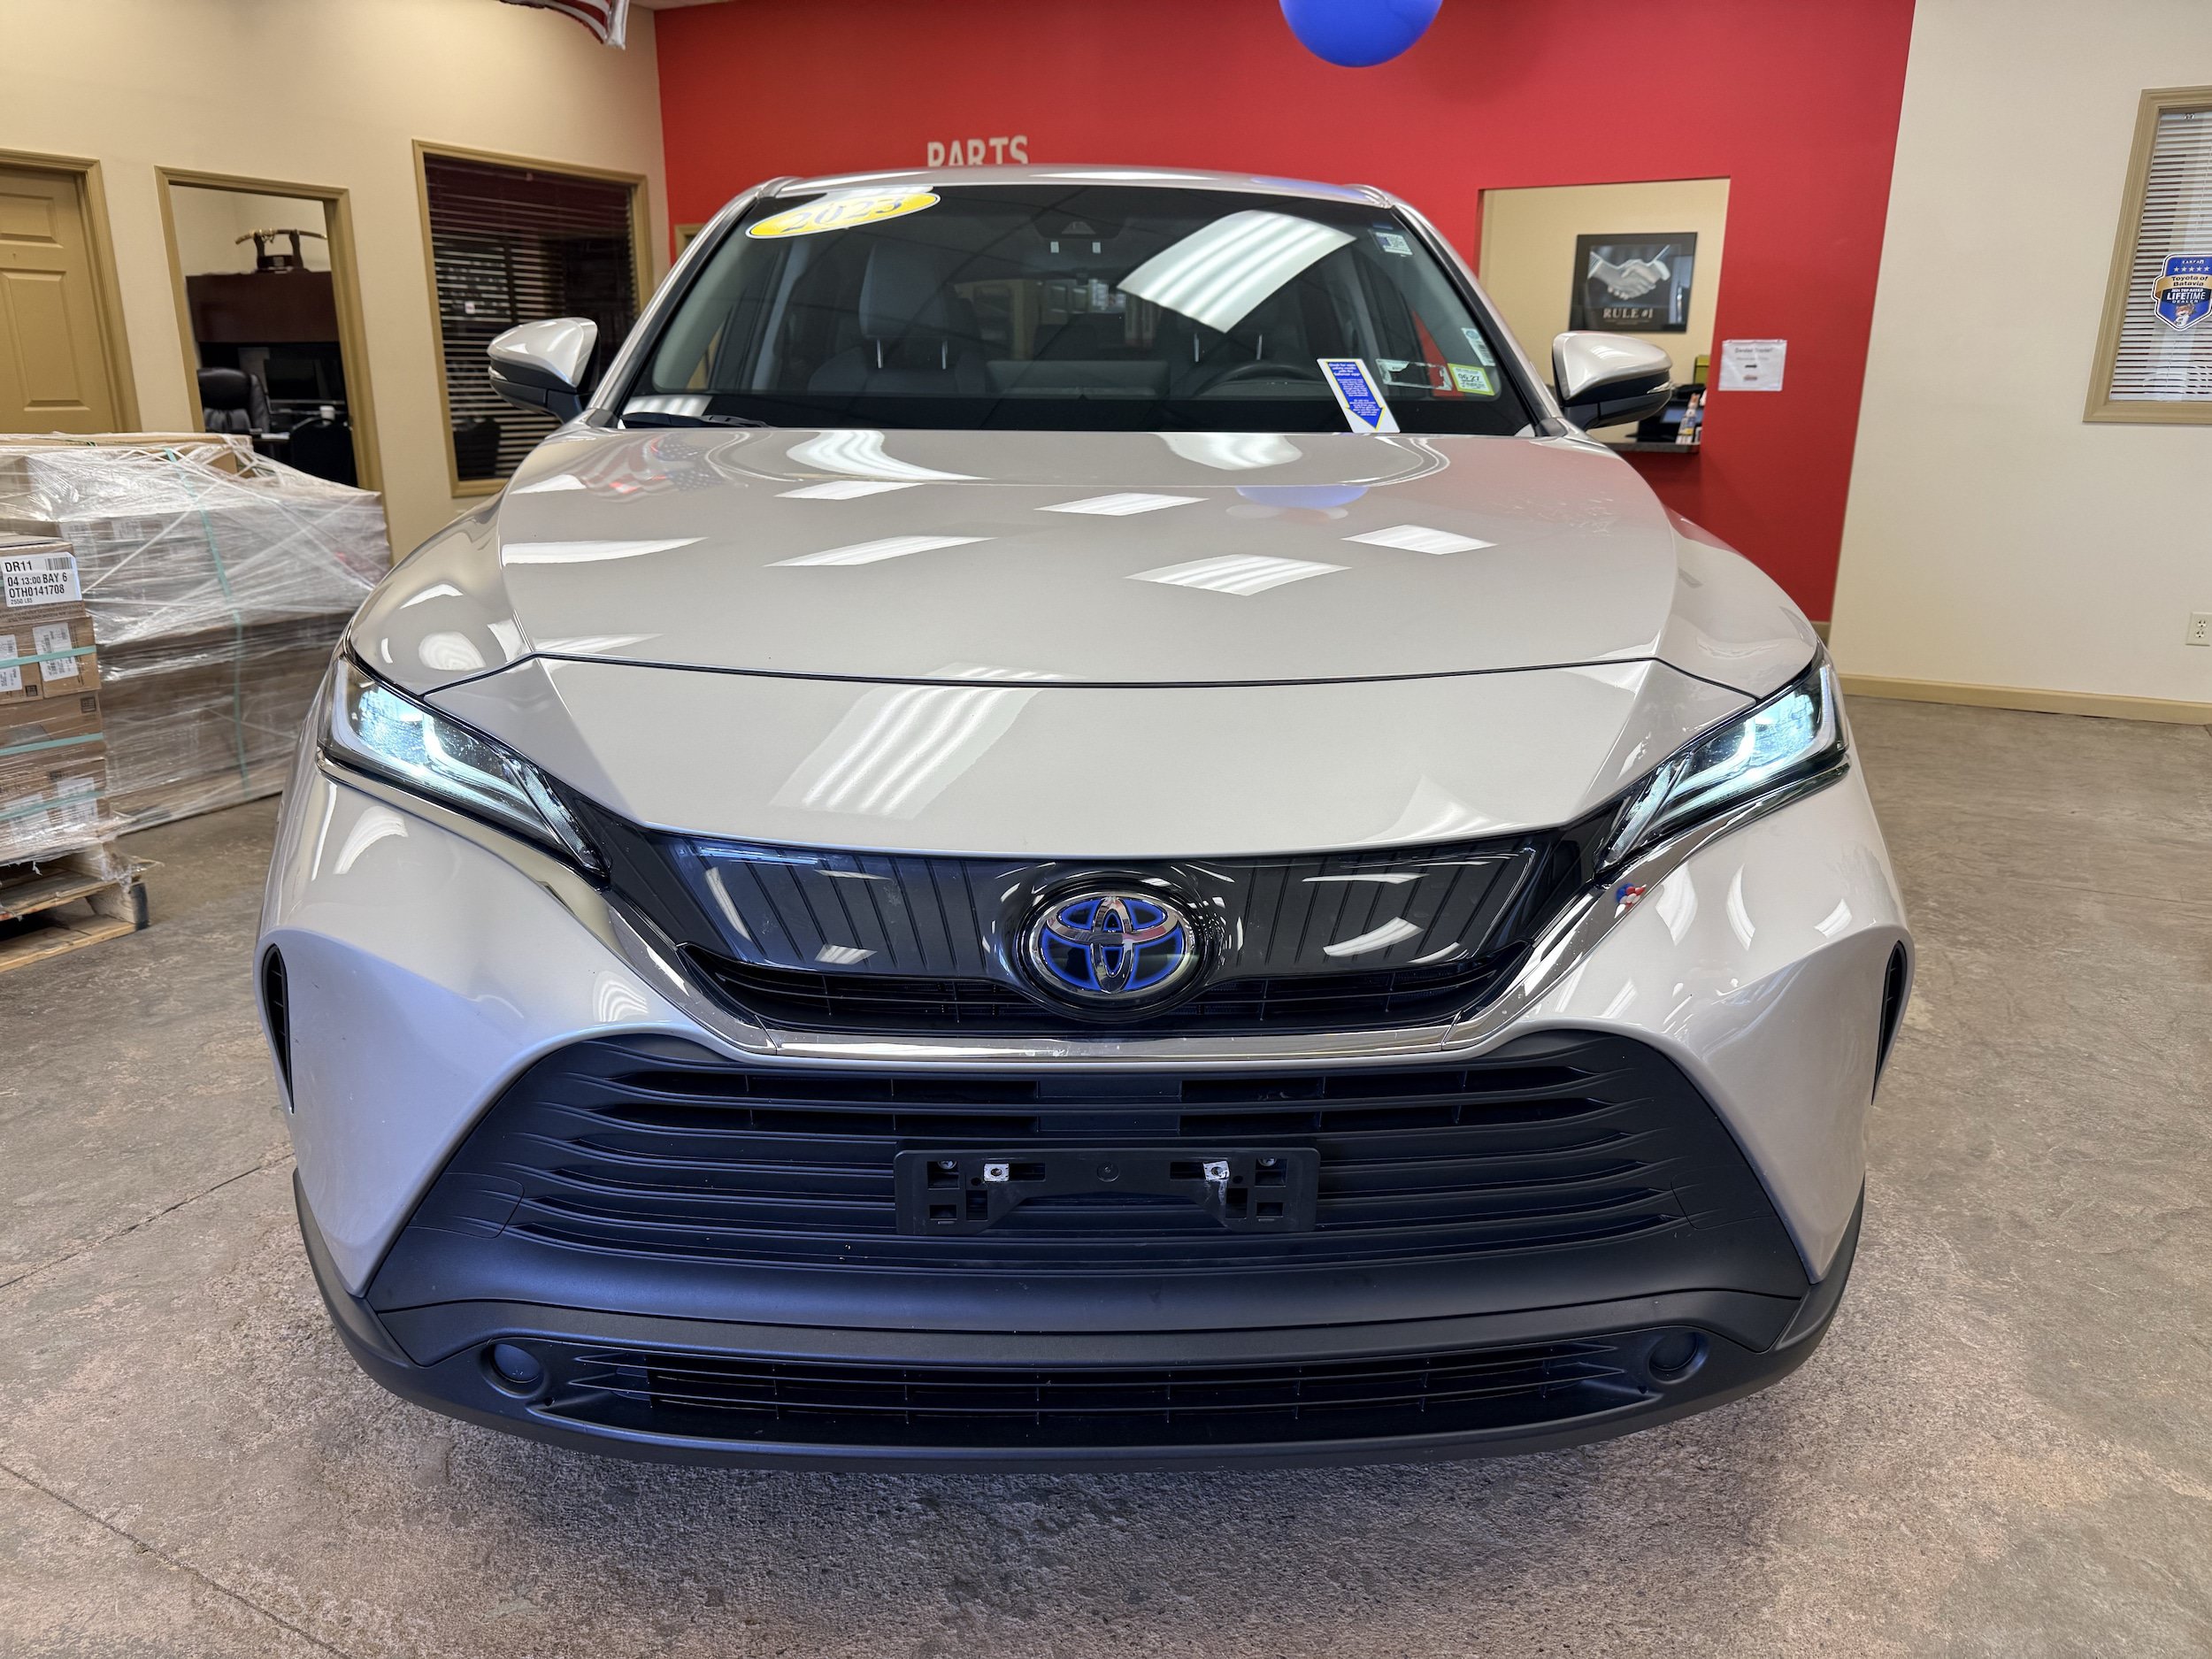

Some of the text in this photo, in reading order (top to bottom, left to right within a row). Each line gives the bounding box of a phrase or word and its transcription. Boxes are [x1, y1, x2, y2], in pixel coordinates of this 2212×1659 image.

[926, 134, 1029, 167] PARTS
[1603, 307, 1640, 319] RULE
[4, 560, 33, 572] DR11
[7, 572, 68, 587] 04 13:00 BAY 6
